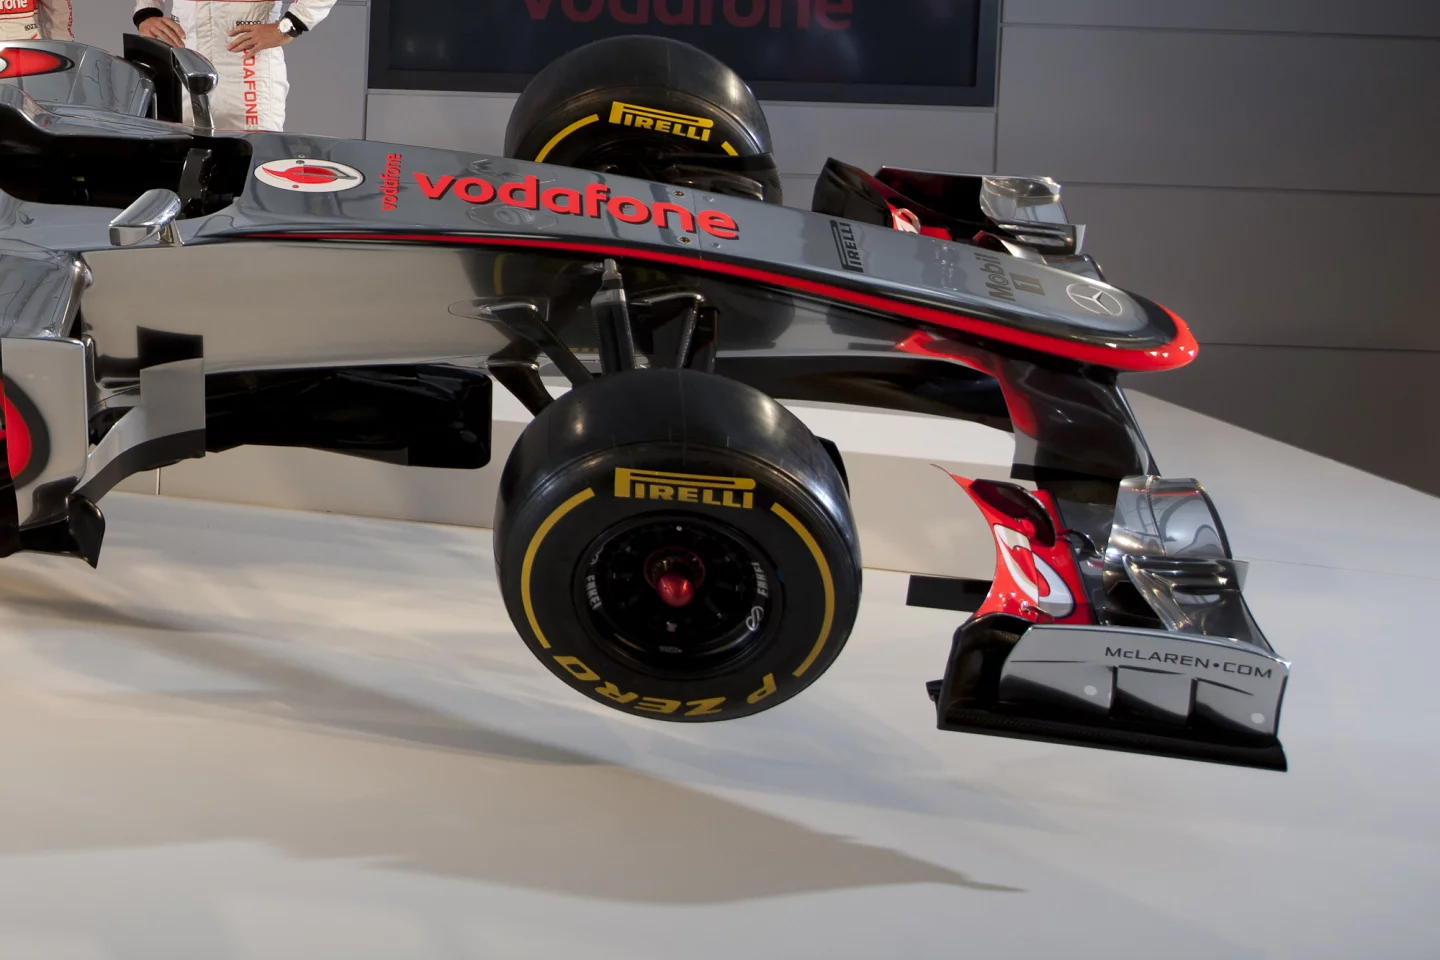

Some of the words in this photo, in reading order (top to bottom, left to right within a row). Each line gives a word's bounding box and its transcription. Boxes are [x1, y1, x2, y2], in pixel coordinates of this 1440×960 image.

[243, 49, 258, 125] DAFONE
[609, 101, 713, 142] PIRELLI
[380, 152, 402, 212] vodafone
[413, 171, 740, 240] vodafone
[830, 219, 864, 273] PIRELLI
[974, 252, 1016, 302] Mobil
[614, 467, 757, 509] PIRELLI
[553, 654, 727, 716] ZERO
[747, 672, 778, 705] P
